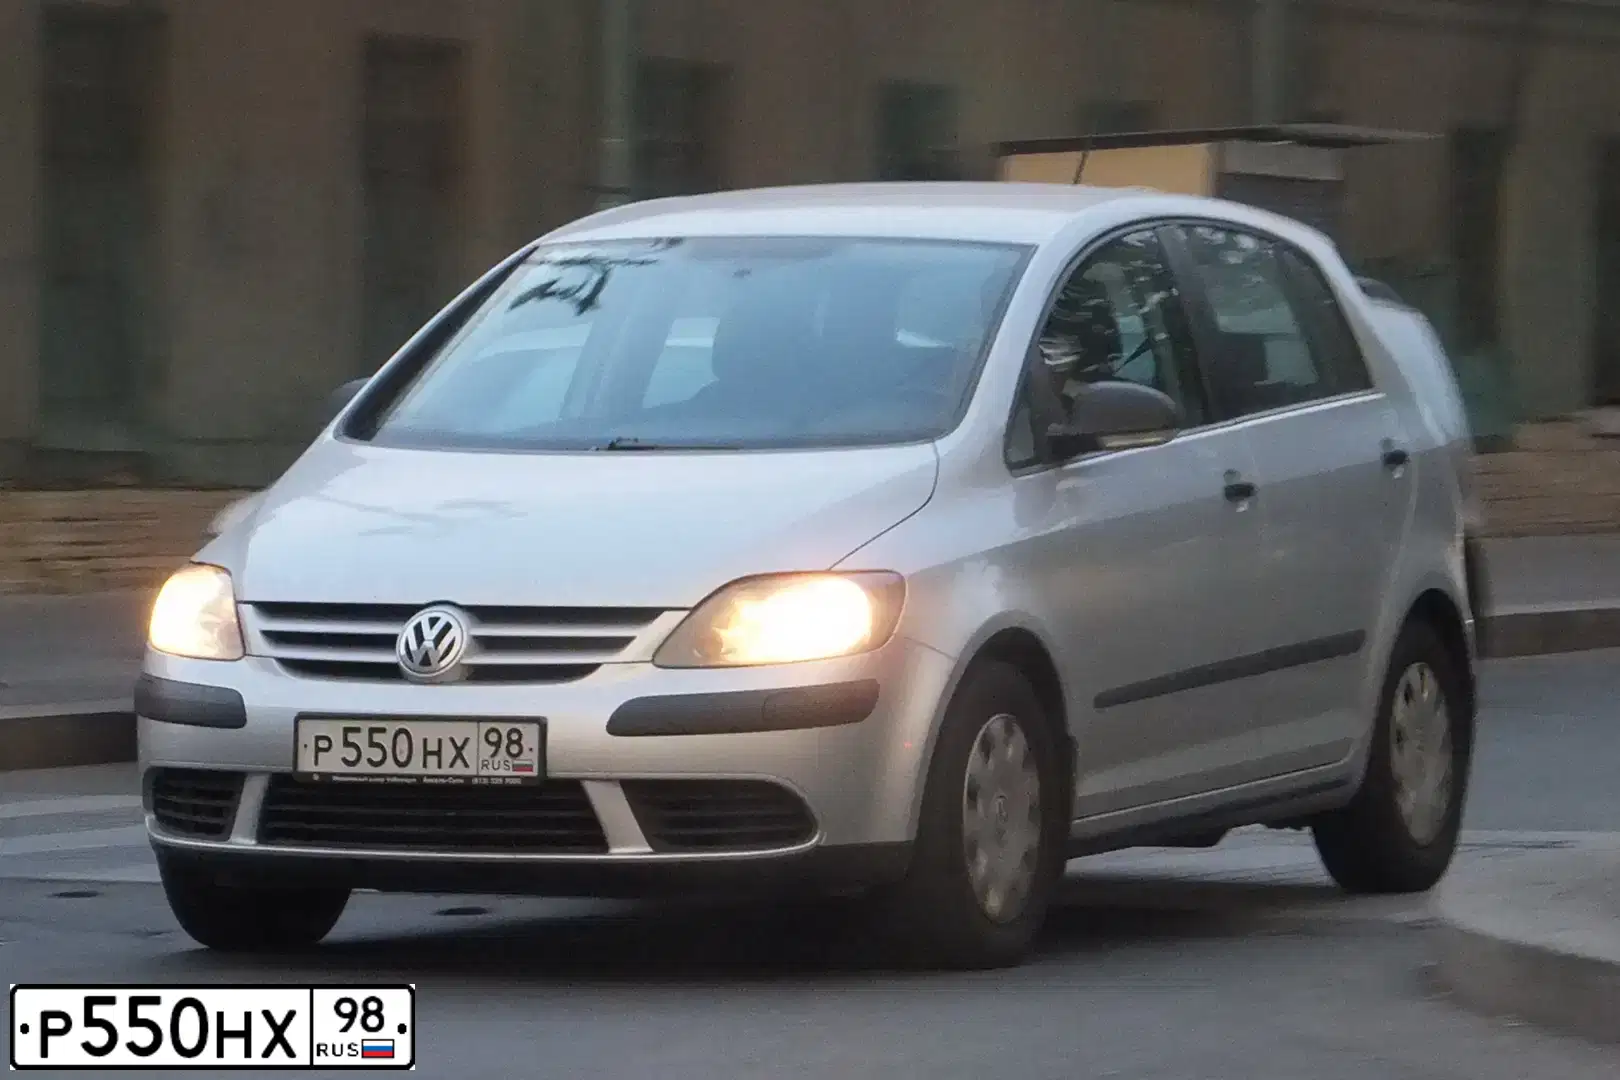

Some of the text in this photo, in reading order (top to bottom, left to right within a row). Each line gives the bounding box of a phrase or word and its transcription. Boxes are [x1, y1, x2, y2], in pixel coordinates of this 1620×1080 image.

[313, 727, 523, 769] P550HX 98
[481, 760, 511, 771] RUS
